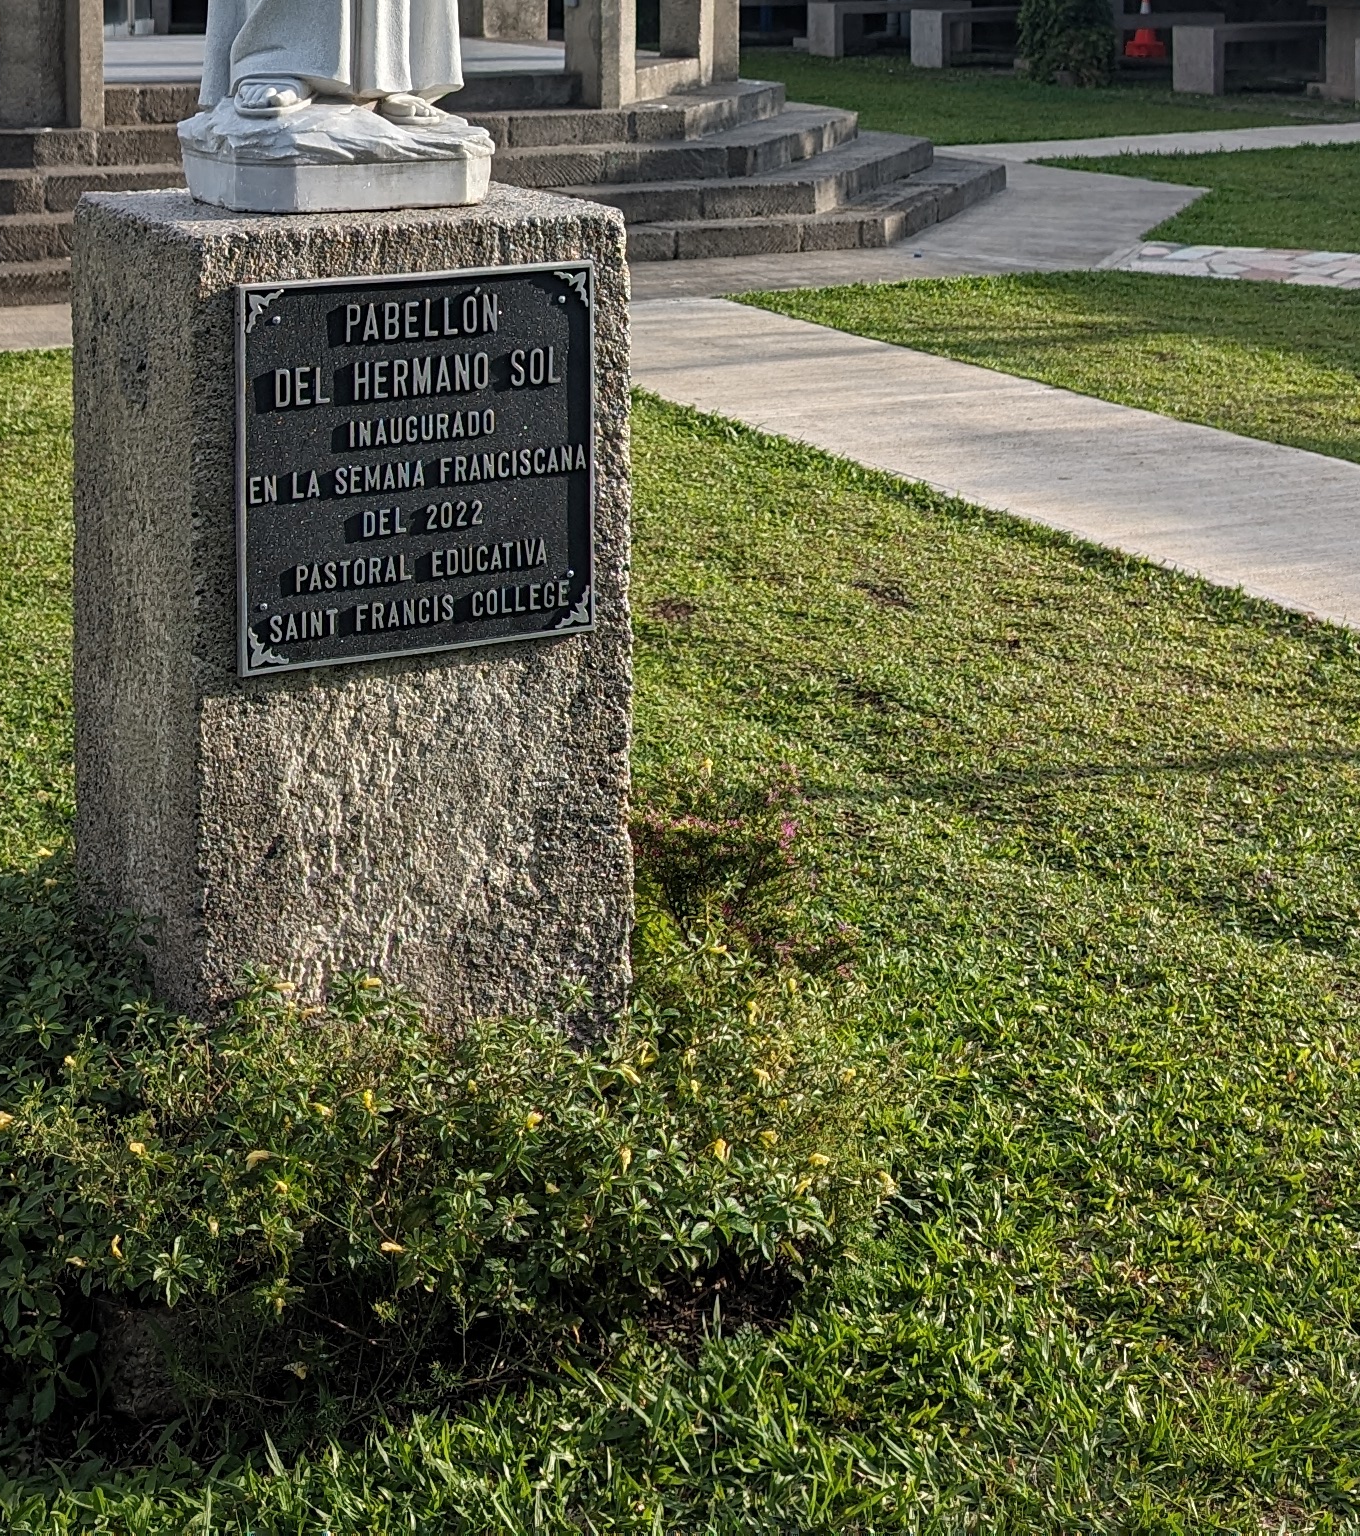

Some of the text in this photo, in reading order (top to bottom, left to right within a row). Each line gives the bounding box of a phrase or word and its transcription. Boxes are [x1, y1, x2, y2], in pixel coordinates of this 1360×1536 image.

[345, 287, 498, 343] PABELLÓN
[275, 346, 561, 408] DEL HERMANO SOL
[349, 409, 495, 447] INAUGURADO
[249, 445, 587, 505] EN LA SEMANA FRANCISCANA
[363, 500, 483, 537] DEL 2022
[296, 539, 548, 592] PASTORAL EDUCATIVA
[270, 580, 570, 644] SAINT FRANCIS COLLEGE
